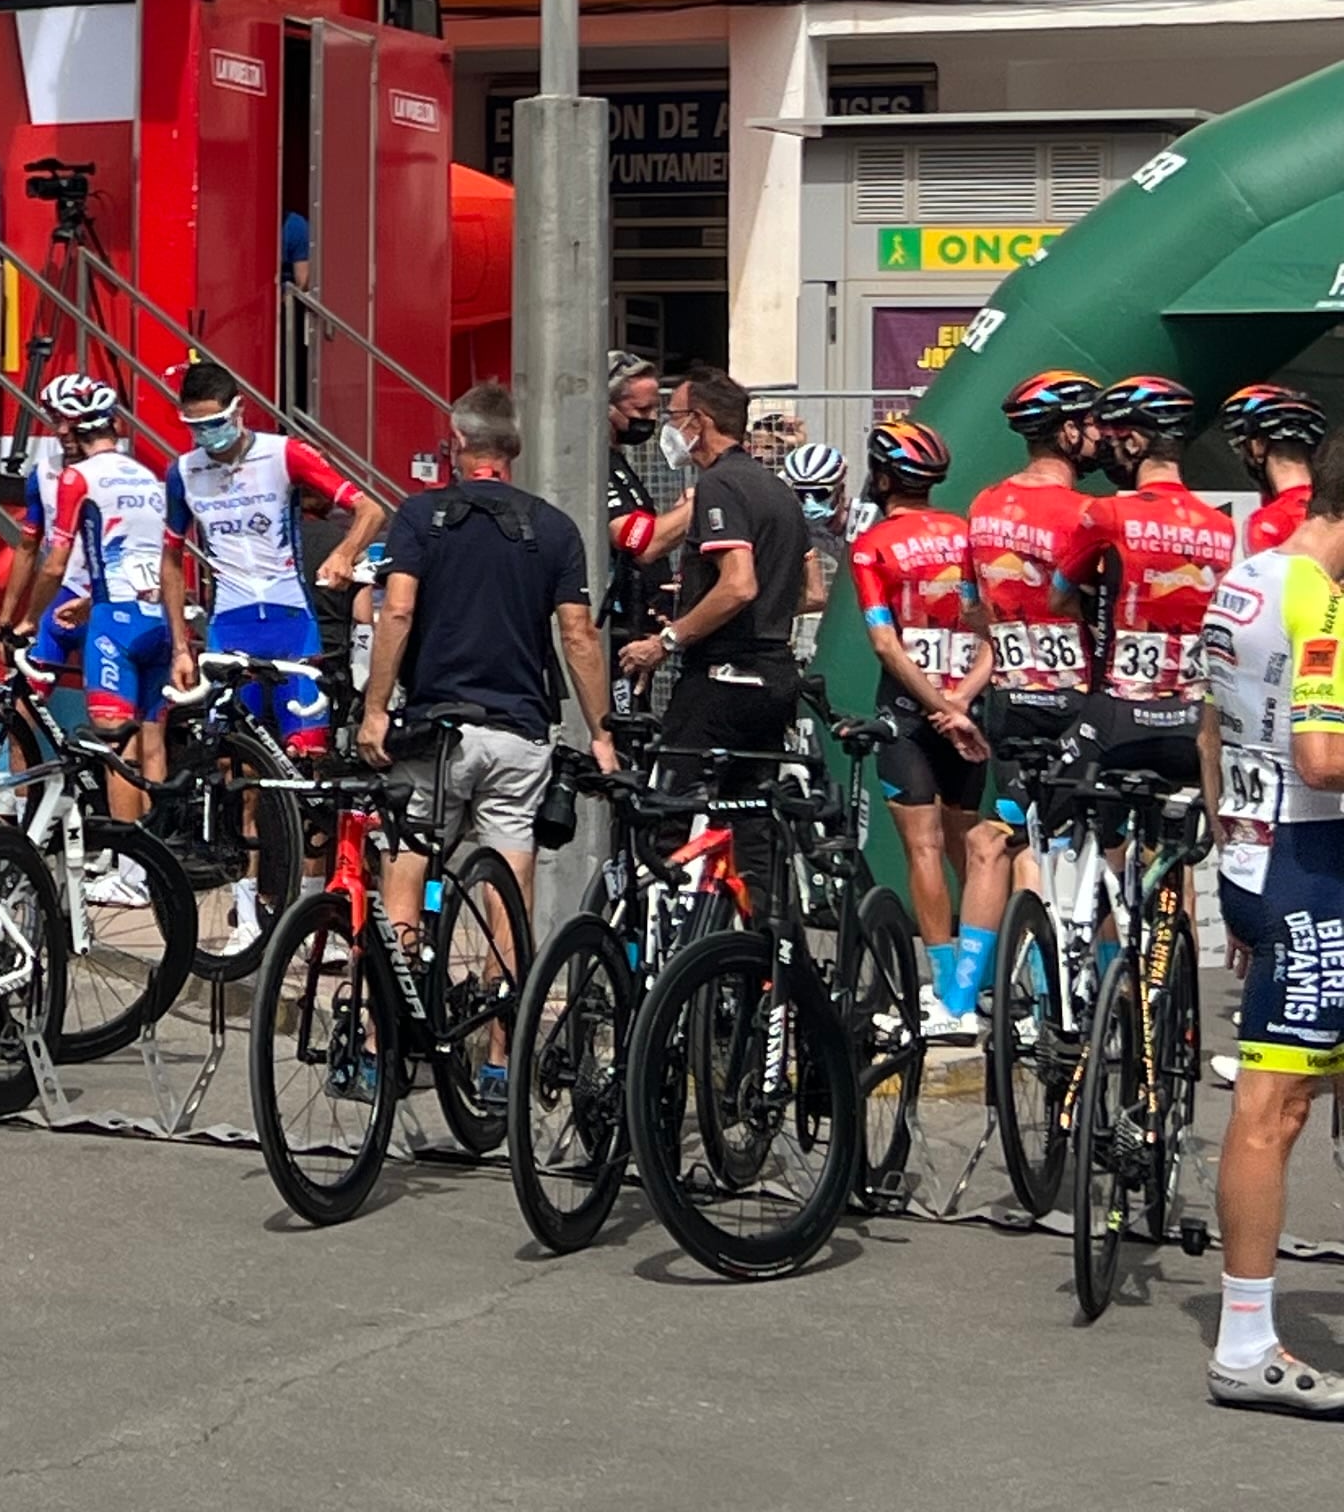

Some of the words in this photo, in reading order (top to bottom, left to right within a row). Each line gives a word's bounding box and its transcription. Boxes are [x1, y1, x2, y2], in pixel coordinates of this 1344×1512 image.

[658, 109, 700, 140] DE
[116, 494, 145, 510] FDJ
[193, 492, 277, 513] Groupama
[209, 520, 242, 535] FDJ
[1124, 519, 1233, 550] BAHRAIN
[890, 533, 969, 561] BAHRA
[916, 638, 942, 671] 31
[1038, 635, 1077, 669] 36
[1120, 643, 1161, 680] 33
[100, 657, 122, 691] FDJ
[367, 889, 427, 1020] MERIDA
[763, 1004, 788, 1094] CANYON
